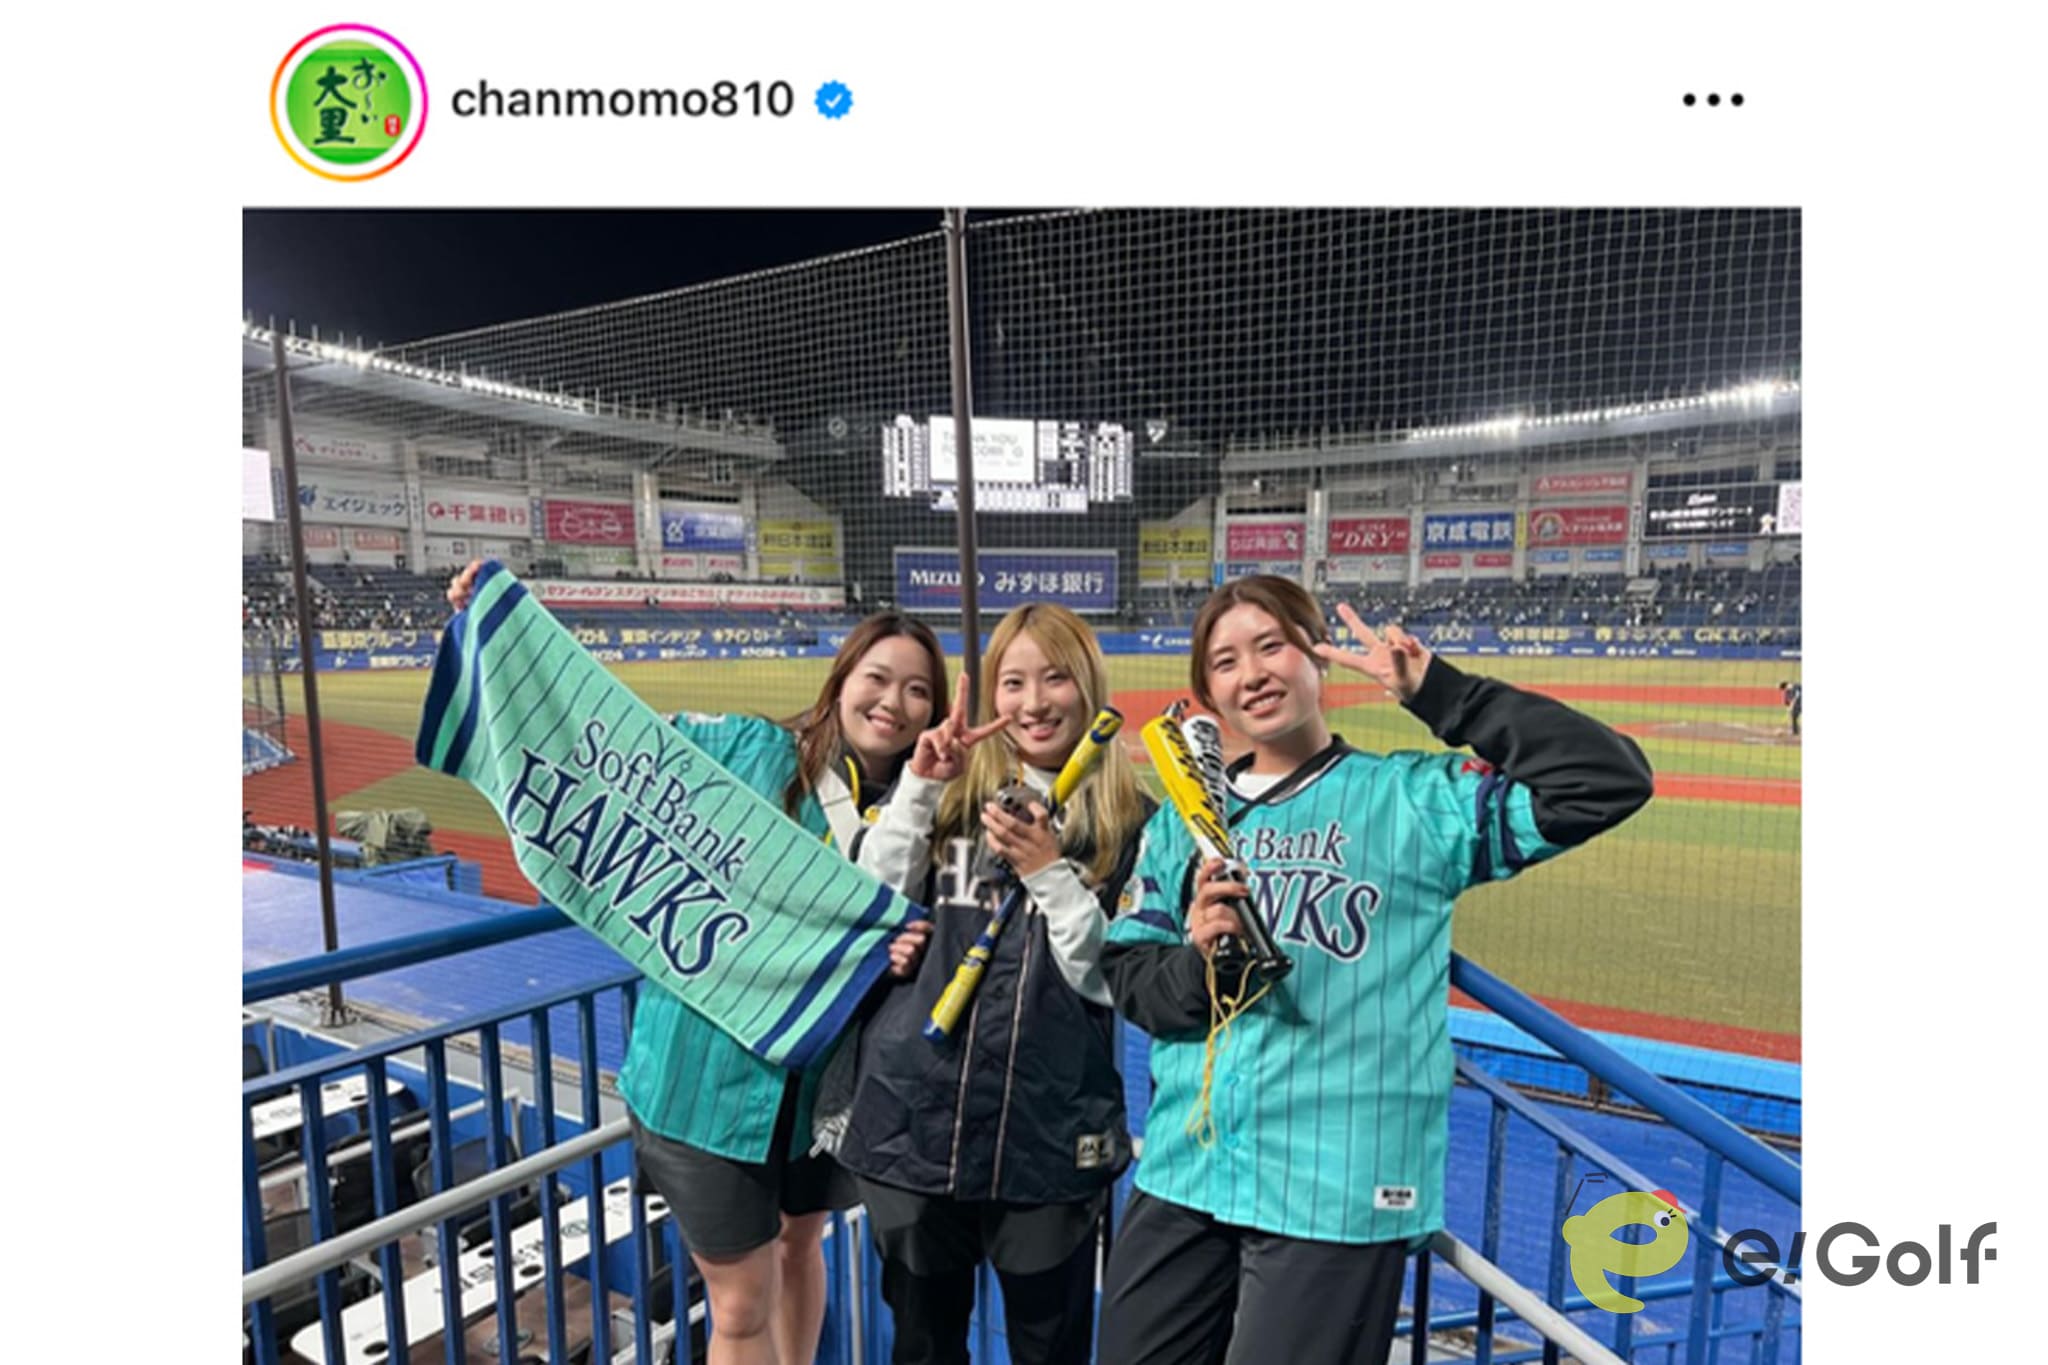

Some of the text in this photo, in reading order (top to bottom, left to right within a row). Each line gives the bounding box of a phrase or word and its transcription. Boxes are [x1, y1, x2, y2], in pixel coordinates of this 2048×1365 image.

[448, 503, 527, 526] 千葉銀行
[1427, 521, 1513, 542] 京成電鉄
[909, 570, 986, 586] MIZUO
[994, 571, 1105, 594] みずほ銀行
[573, 720, 747, 882] SoftBank
[505, 748, 750, 976] HAWKS
[1249, 868, 1380, 960] WKS
